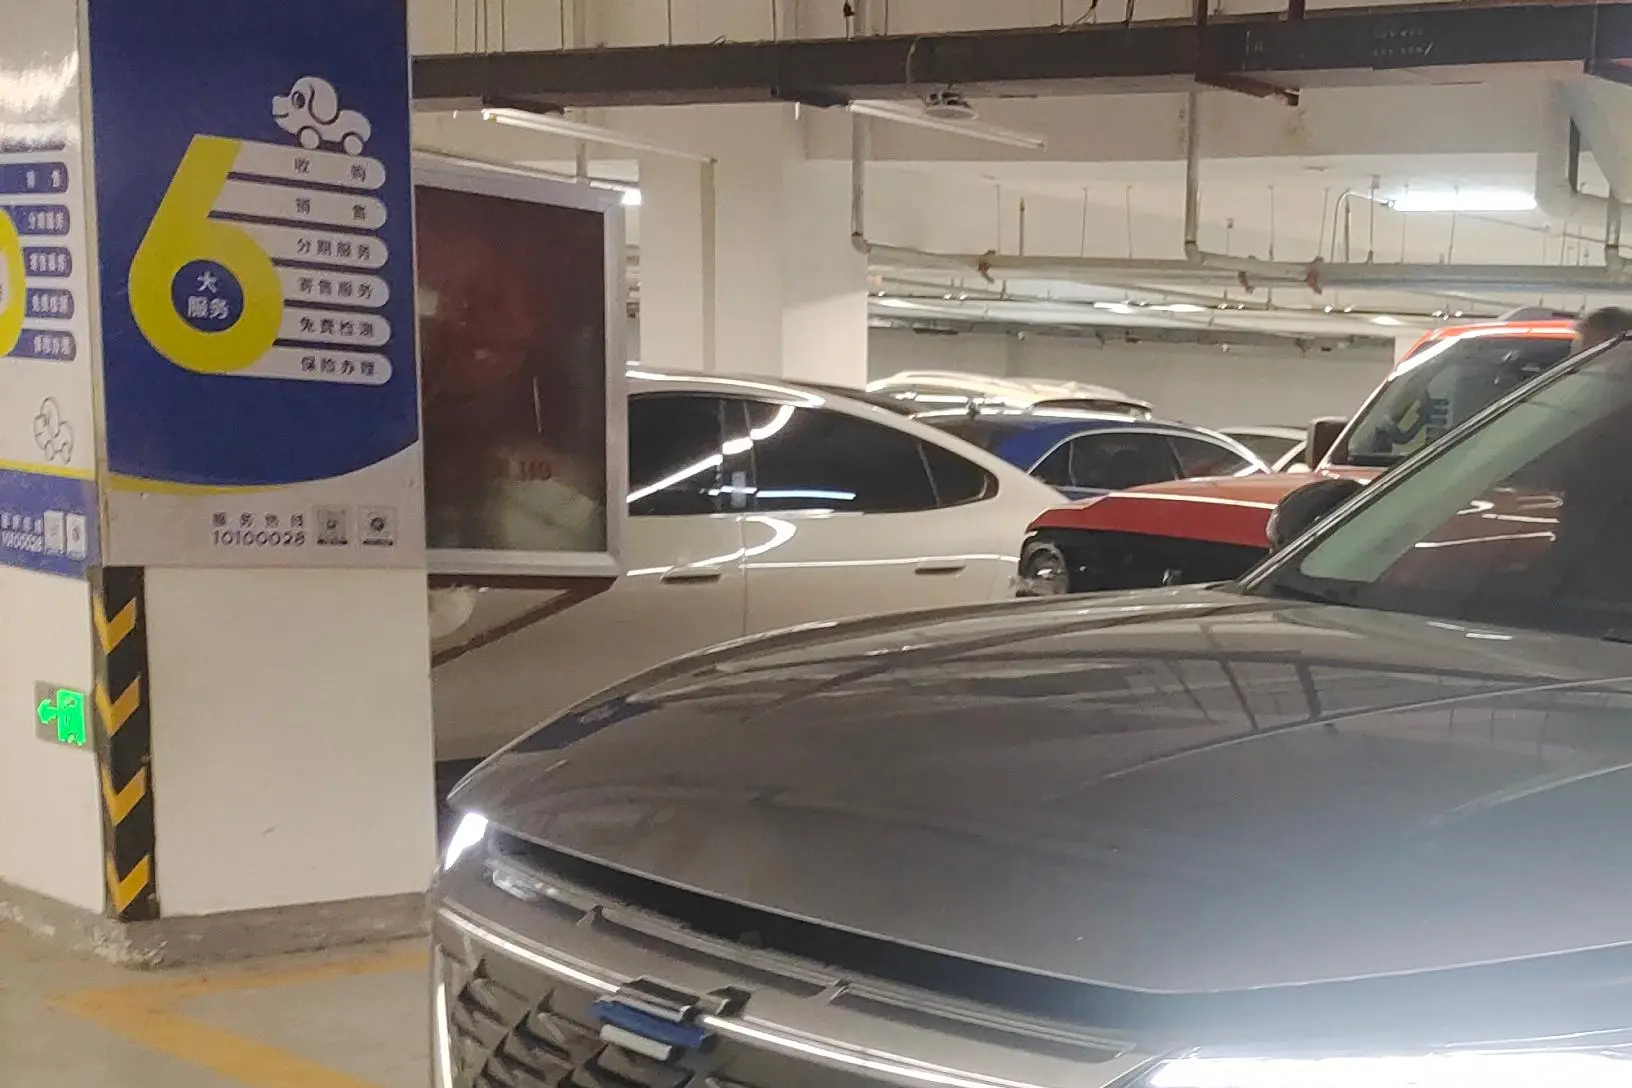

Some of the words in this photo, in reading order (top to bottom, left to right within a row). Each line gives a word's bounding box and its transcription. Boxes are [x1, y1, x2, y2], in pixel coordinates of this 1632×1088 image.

[296, 238, 370, 260] 分期服务
[197, 270, 217, 293] 大
[188, 295, 229, 319] 服务
[300, 316, 375, 338] 免费检测
[301, 356, 376, 377] 保险办理
